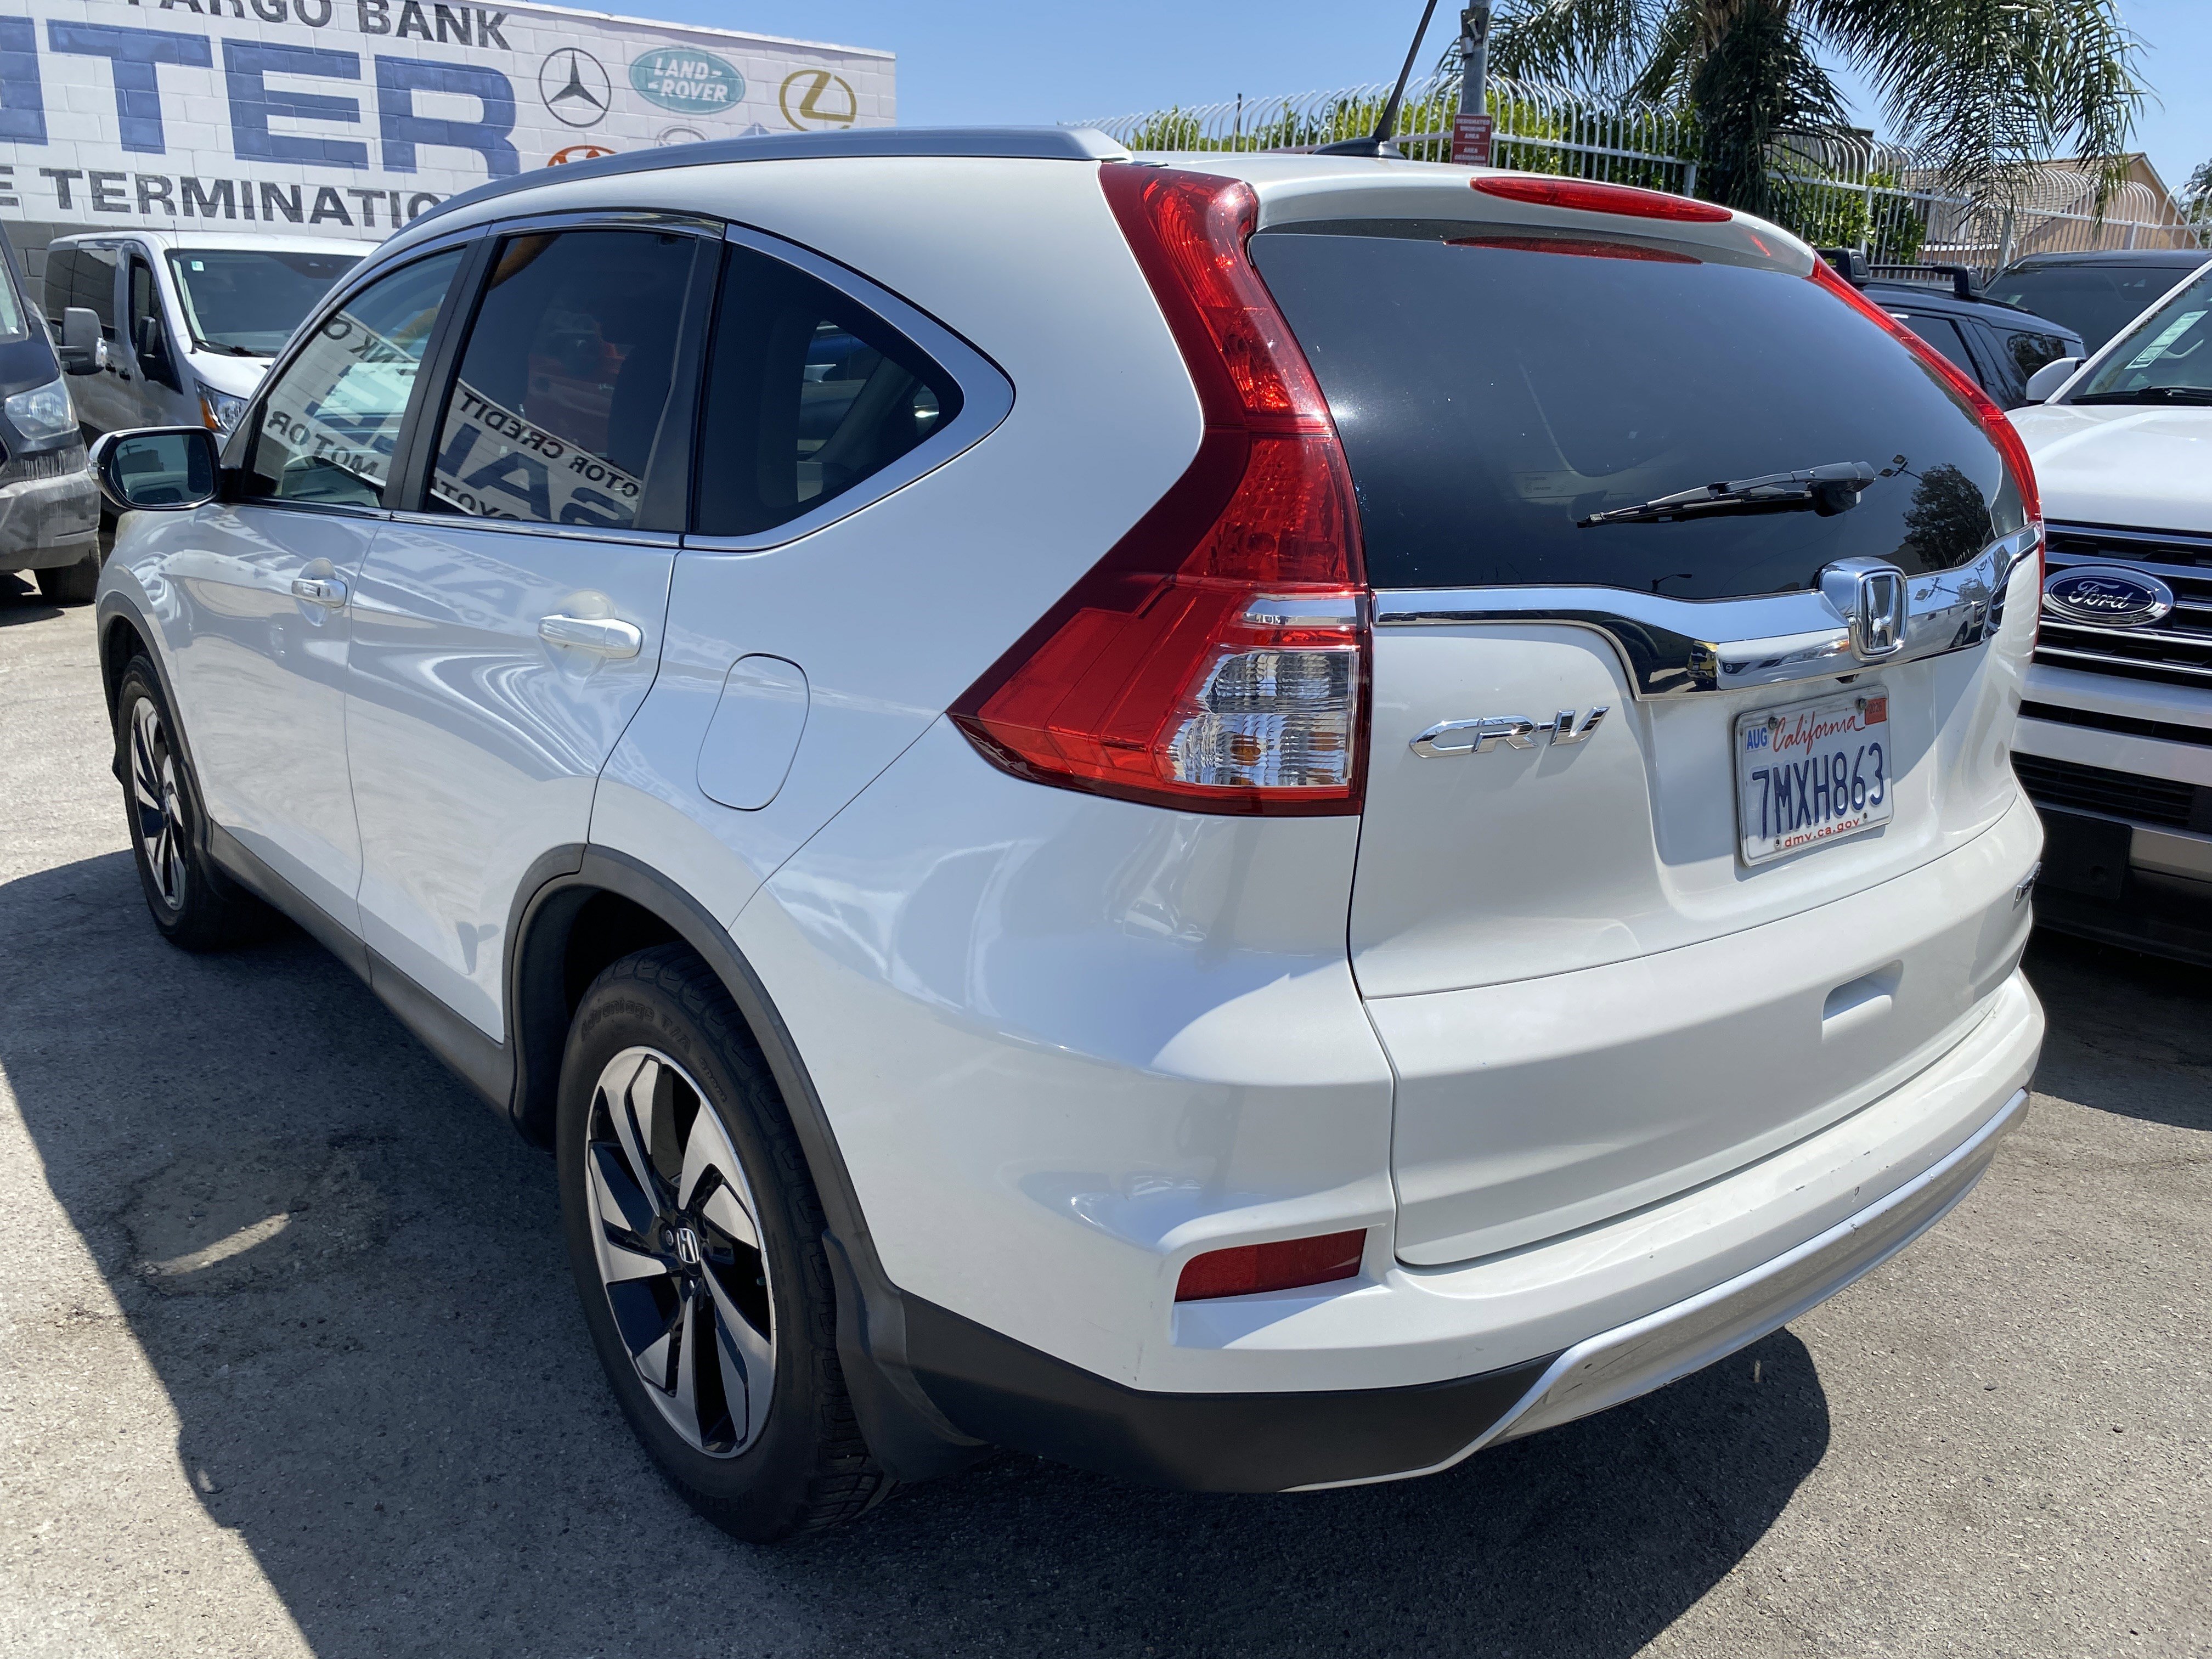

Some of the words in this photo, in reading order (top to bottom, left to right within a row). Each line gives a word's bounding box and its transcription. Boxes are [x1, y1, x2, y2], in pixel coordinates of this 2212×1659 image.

[357, 0, 512, 50] BANK
[2068, 580, 2134, 610] Ford
[1409, 706, 1611, 758] CR-V
[1747, 727, 1768, 751] AUG
[1773, 708, 1866, 755] California
[1752, 742, 1884, 839] 7MXH863
[1784, 817, 1860, 848] dmv.ca.gov
